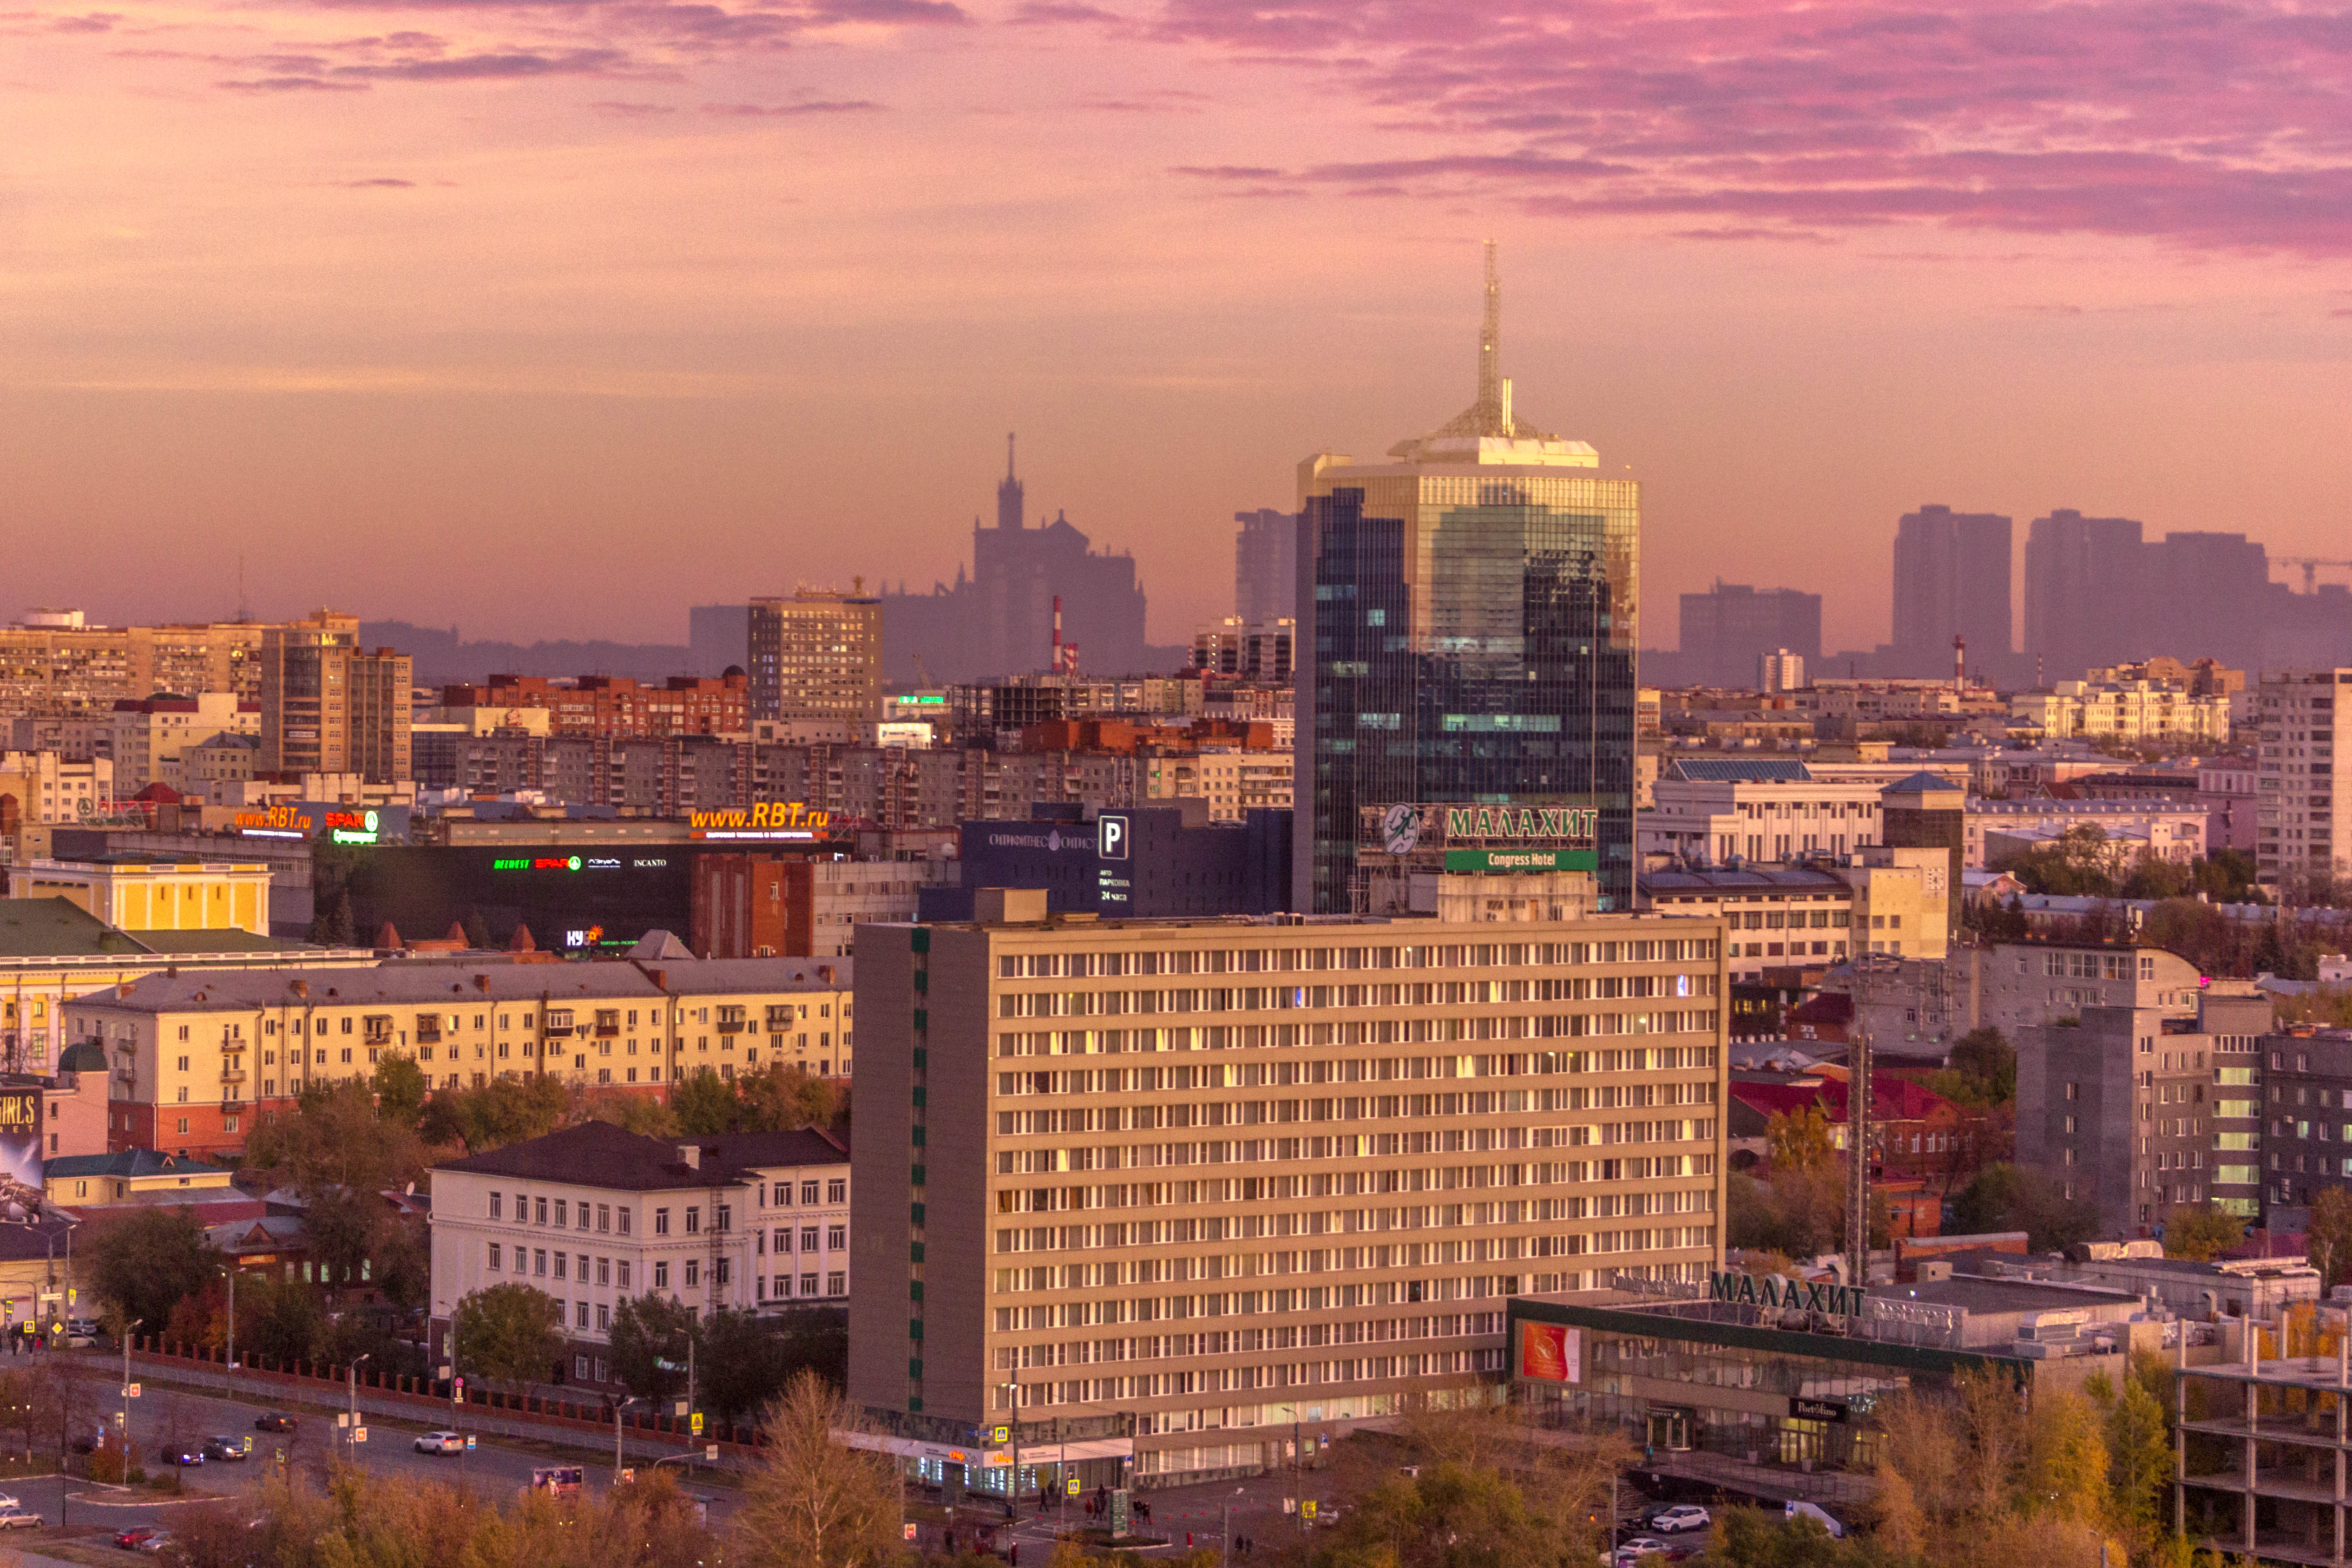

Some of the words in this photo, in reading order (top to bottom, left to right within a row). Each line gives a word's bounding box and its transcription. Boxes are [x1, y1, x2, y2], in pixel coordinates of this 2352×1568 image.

[235, 806, 311, 829] www.RBT.ru
[326, 813, 364, 828] SPAR
[691, 802, 829, 827] www.RBT.ru
[1447, 809, 1598, 837] МАЛАХИТ
[989, 833, 1048, 847] СИТИФИТНЕС
[1106, 822, 1120, 852] P
[535, 859, 570, 868] SPAR
[1488, 853, 1530, 867] Congress
[1531, 853, 1556, 866] Hotel
[1099, 878, 1130, 887] ПАРКОВКА
[1102, 891, 1110, 900] 24
[0, 1096, 34, 1124] IRLS
[1709, 1270, 1868, 1319] МАЛАХИТ
[1798, 1401, 1837, 1416] Portofino
